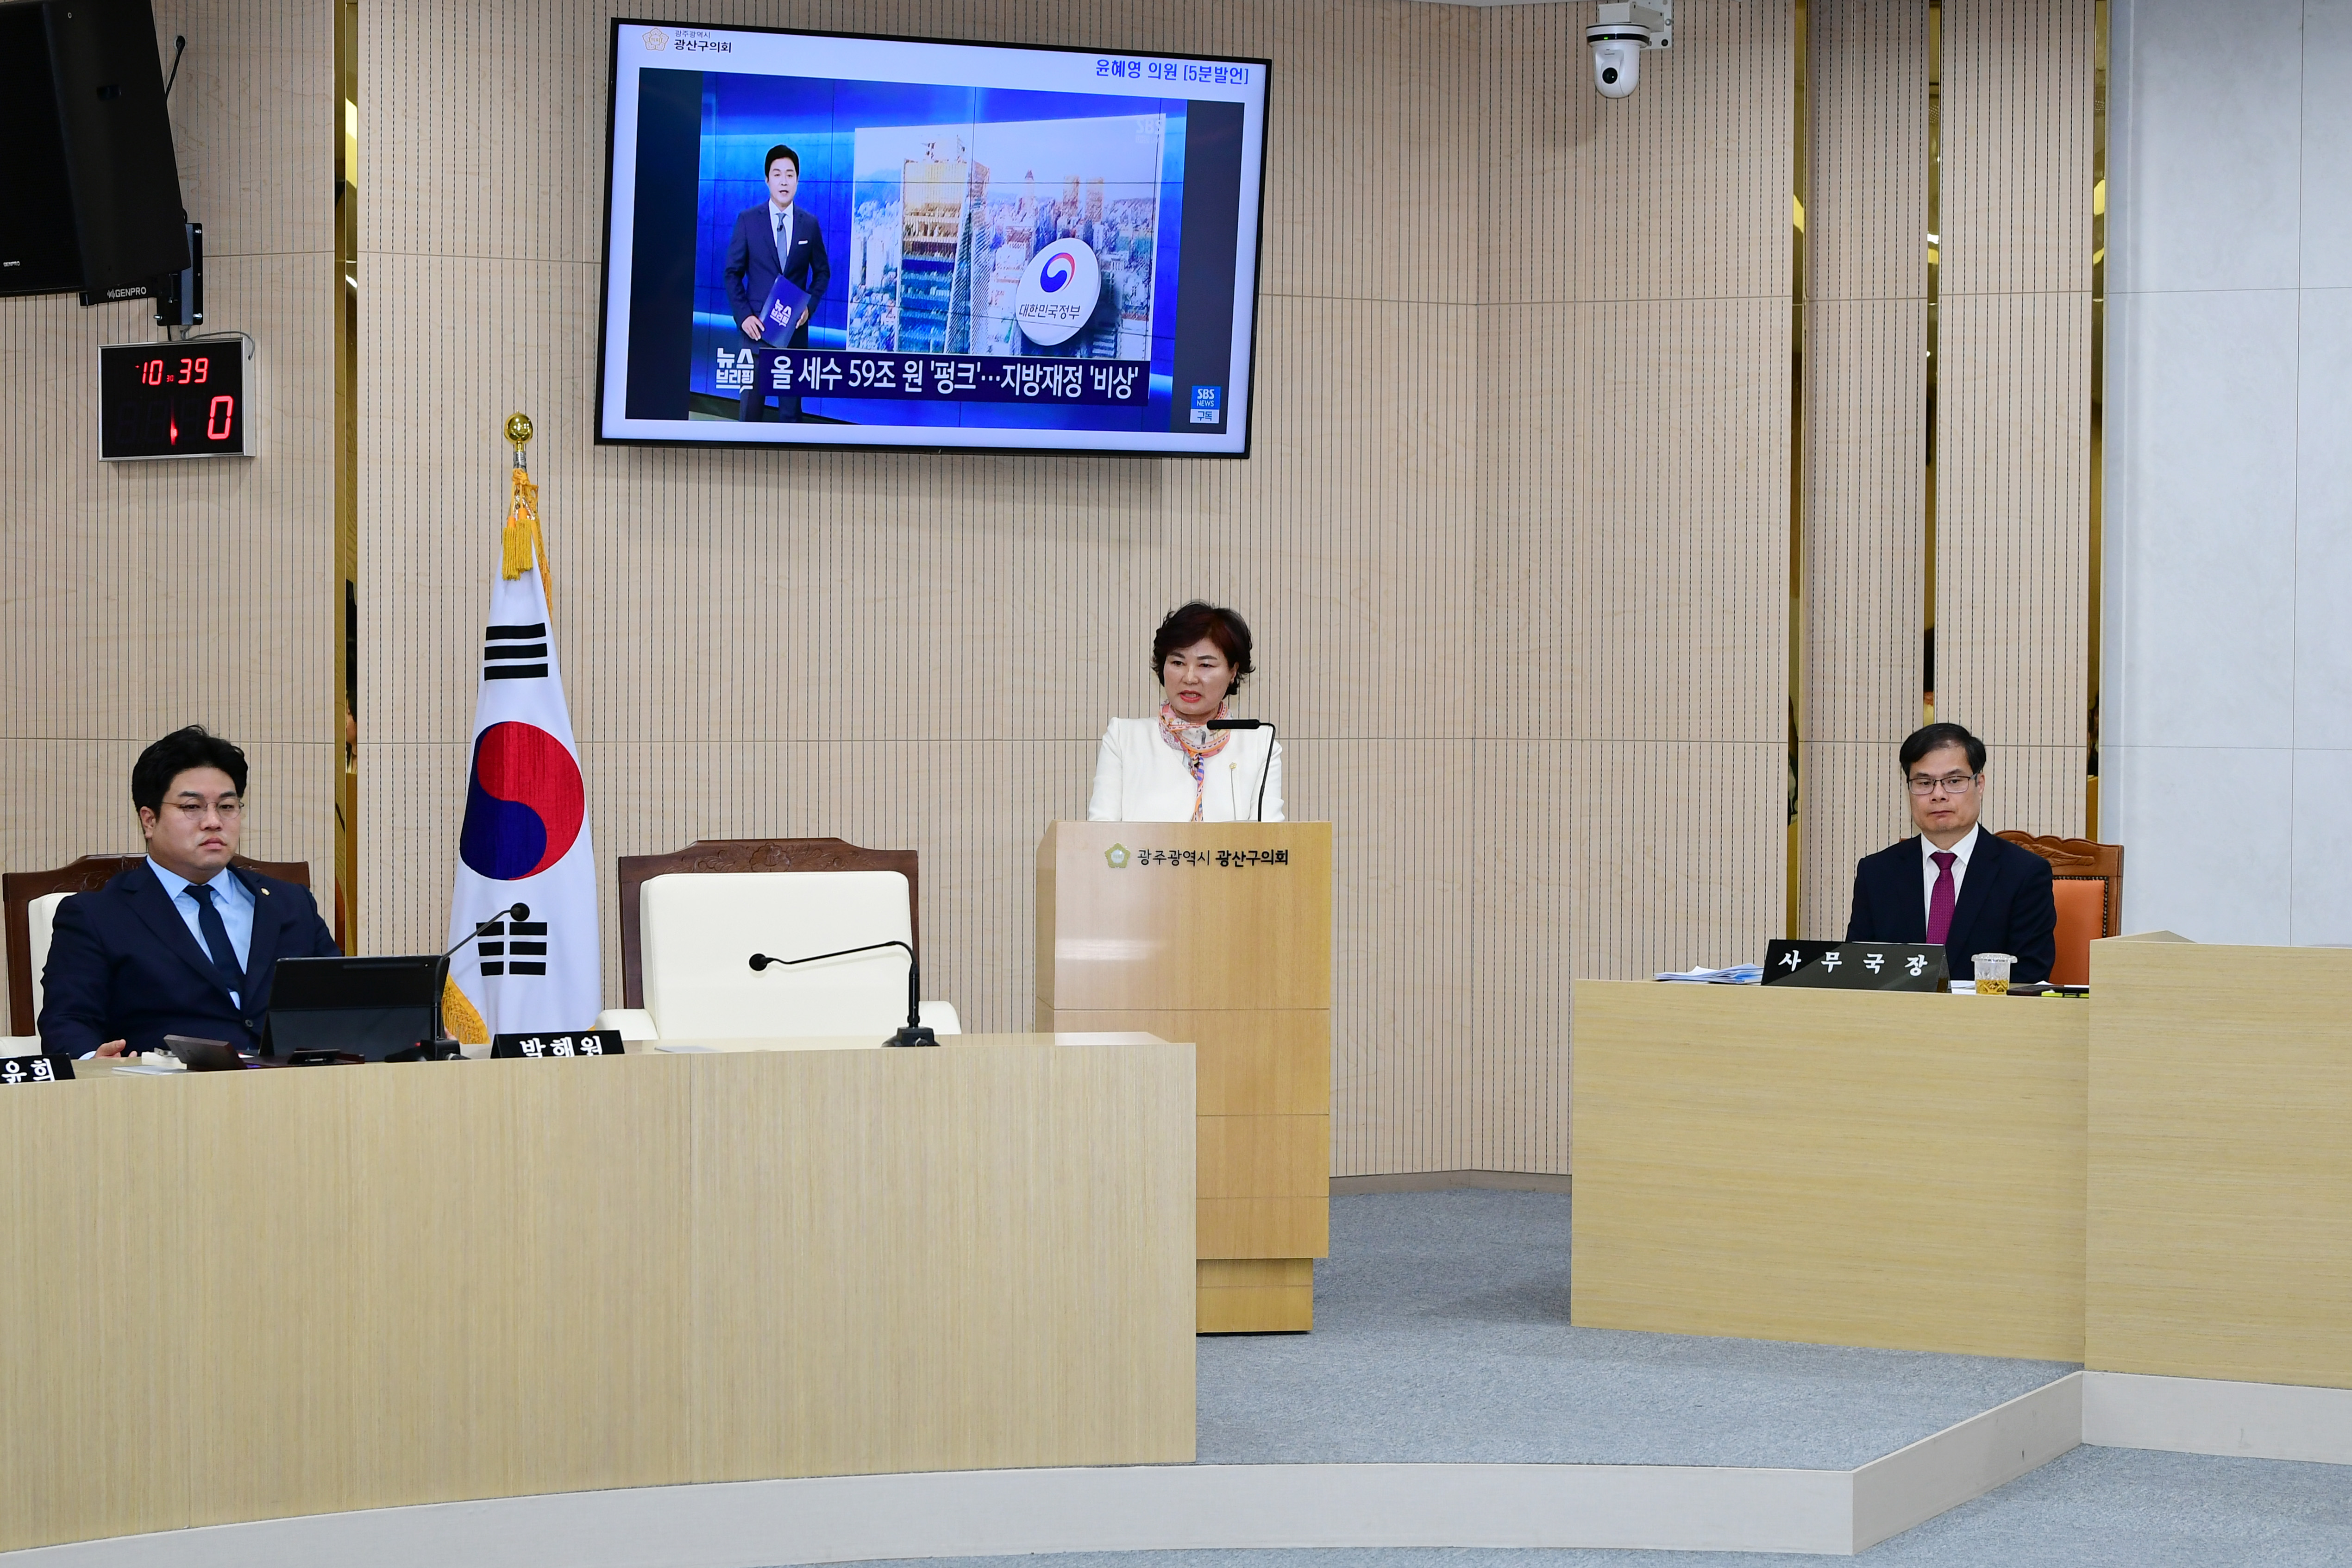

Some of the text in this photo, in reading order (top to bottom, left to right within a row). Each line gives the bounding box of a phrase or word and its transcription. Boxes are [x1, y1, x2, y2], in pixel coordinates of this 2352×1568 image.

[675, 30, 710, 38] 광주광역시
[674, 39, 731, 53] 광산구의회
[1096, 59, 1248, 85] 윤혜영 의원 [5분발언]
[115, 286, 147, 298] GENPRO
[1019, 303, 1081, 320] 대한민국정부
[717, 347, 754, 369] 뉴스
[142, 360, 163, 385] 10
[178, 358, 208, 384] 39
[716, 369, 754, 386] 브리핑
[770, 356, 794, 389] 올
[798, 357, 843, 390] 세수
[848, 360, 896, 388] 59조
[902, 360, 923, 392] 원
[1197, 389, 1215, 400] SBS
[1197, 411, 1212, 421] 구독
[1137, 848, 1289, 867] 광주광역시 광산구의회
